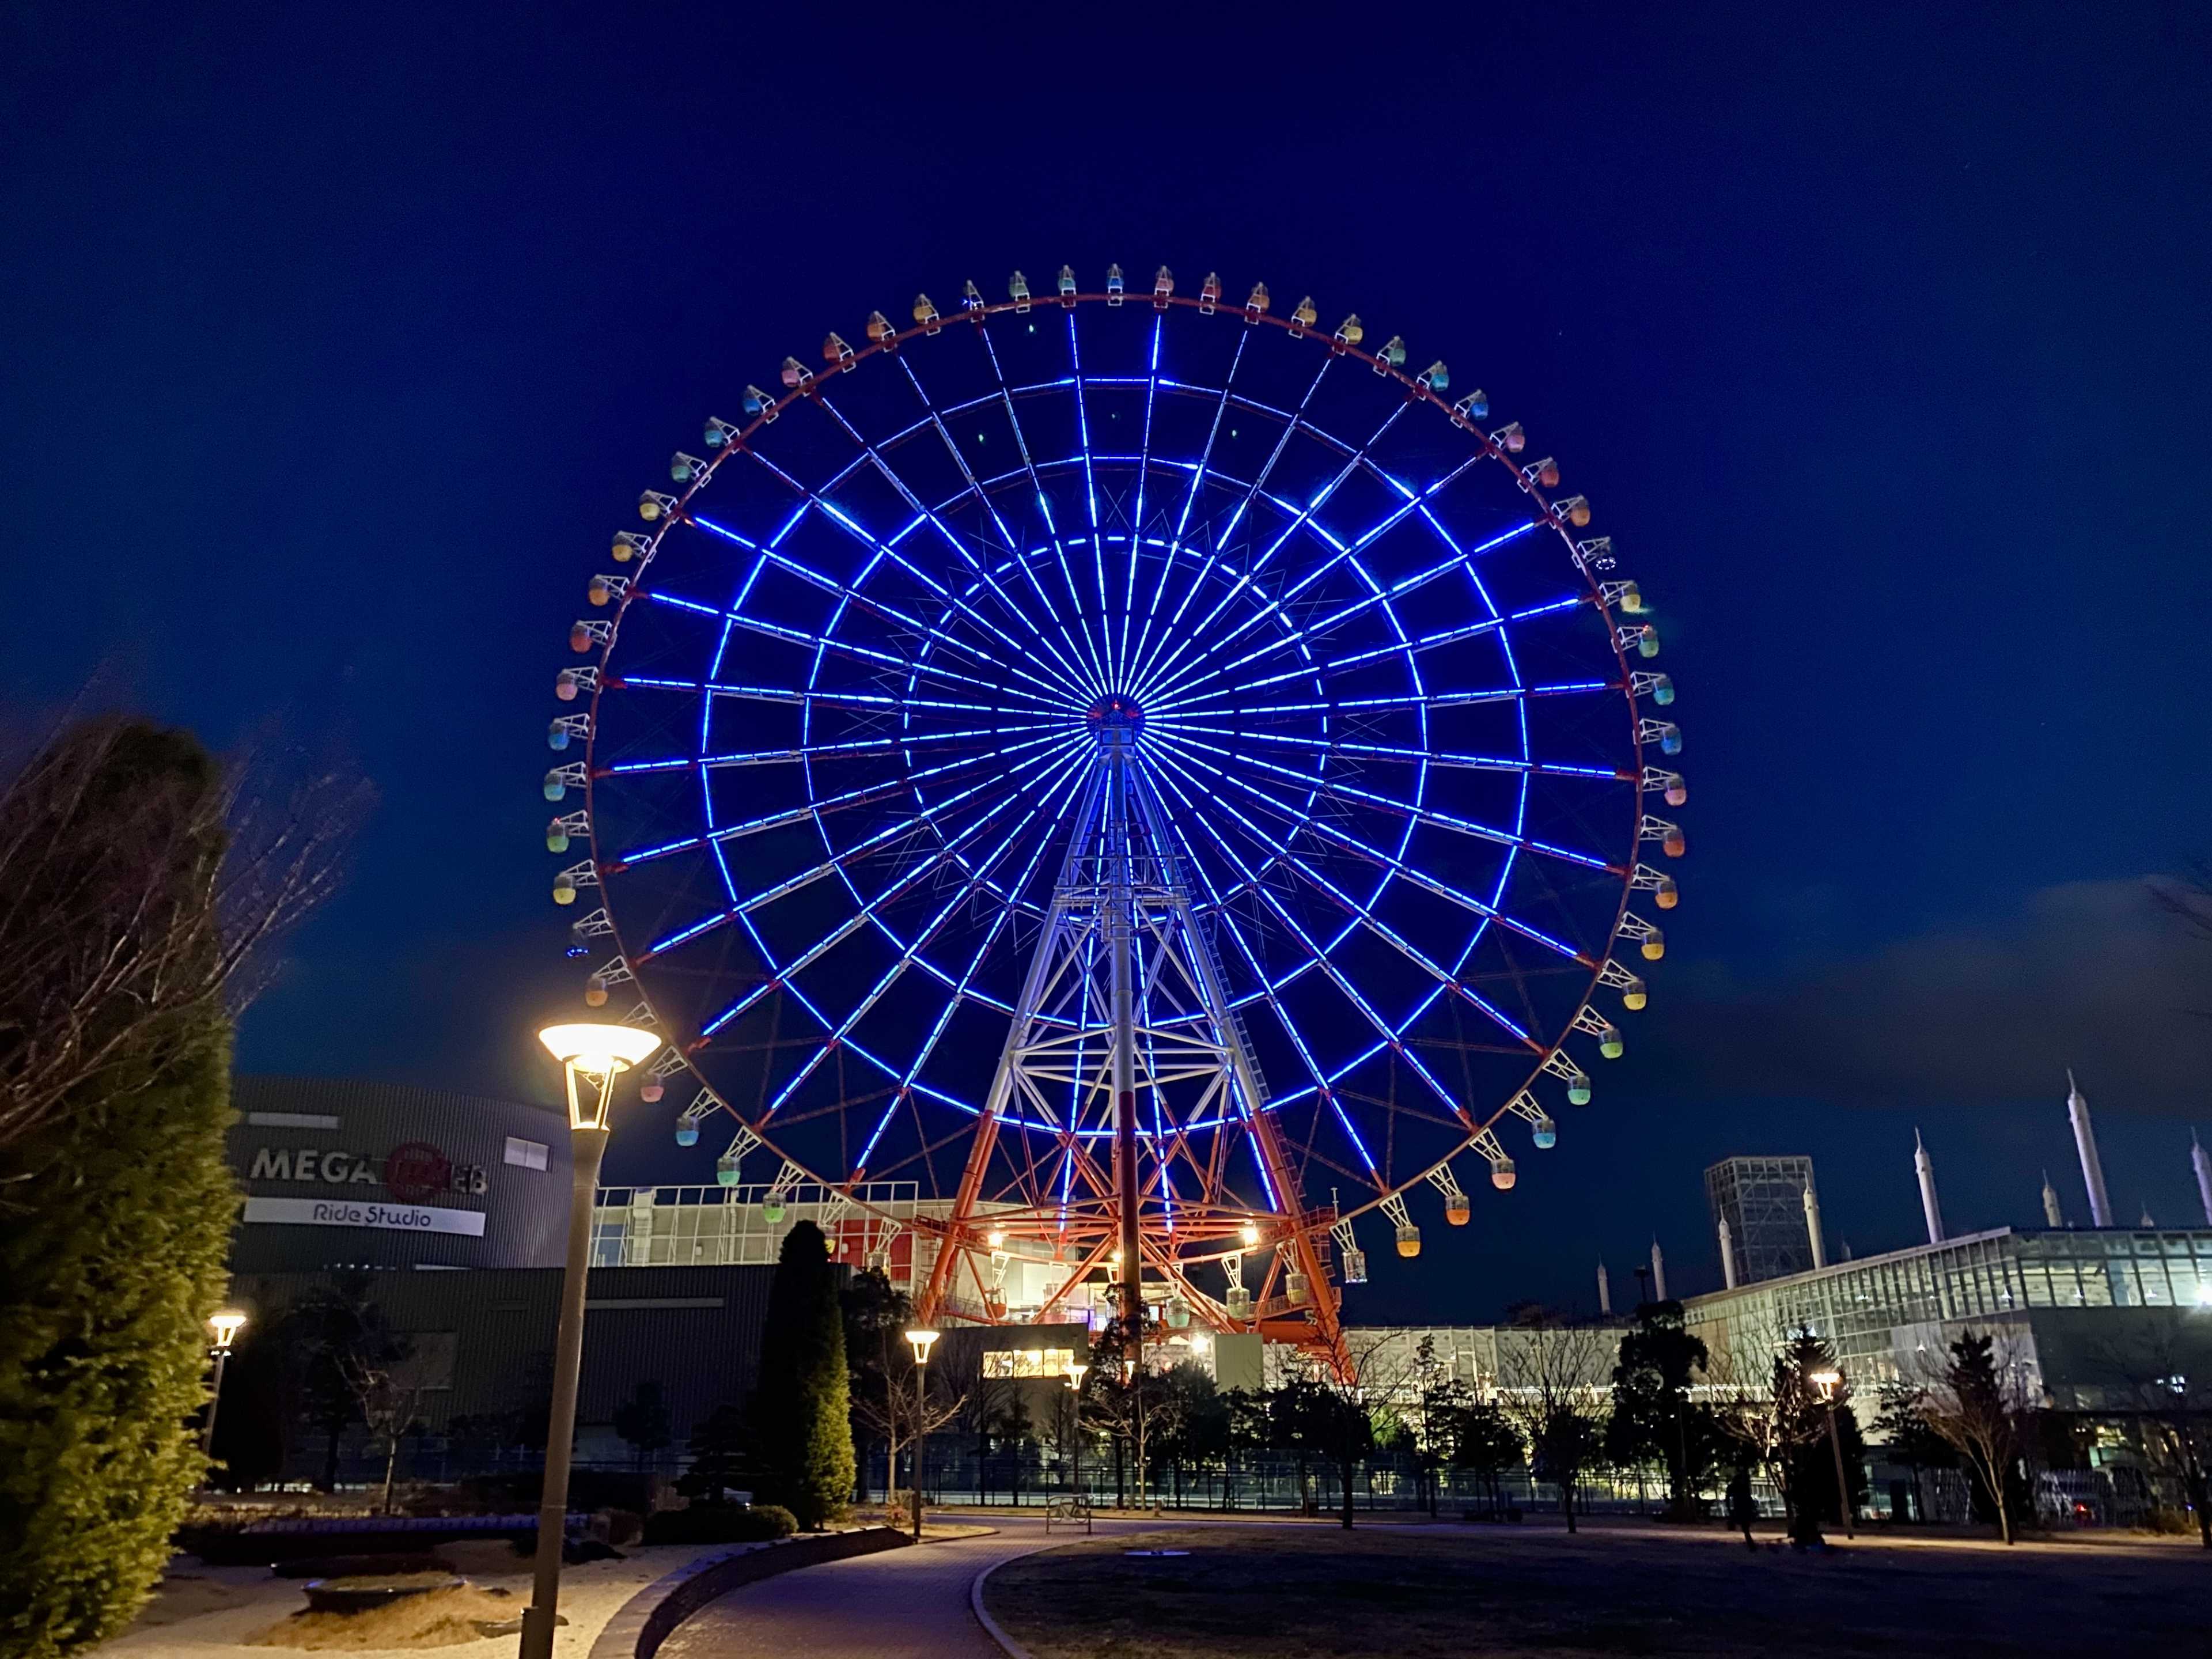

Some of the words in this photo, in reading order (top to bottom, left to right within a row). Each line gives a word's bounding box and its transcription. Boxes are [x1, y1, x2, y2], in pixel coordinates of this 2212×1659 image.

[249, 1147, 378, 1184] MEGA
[313, 1203, 361, 1222] Ride
[365, 1206, 431, 1226] Studio
